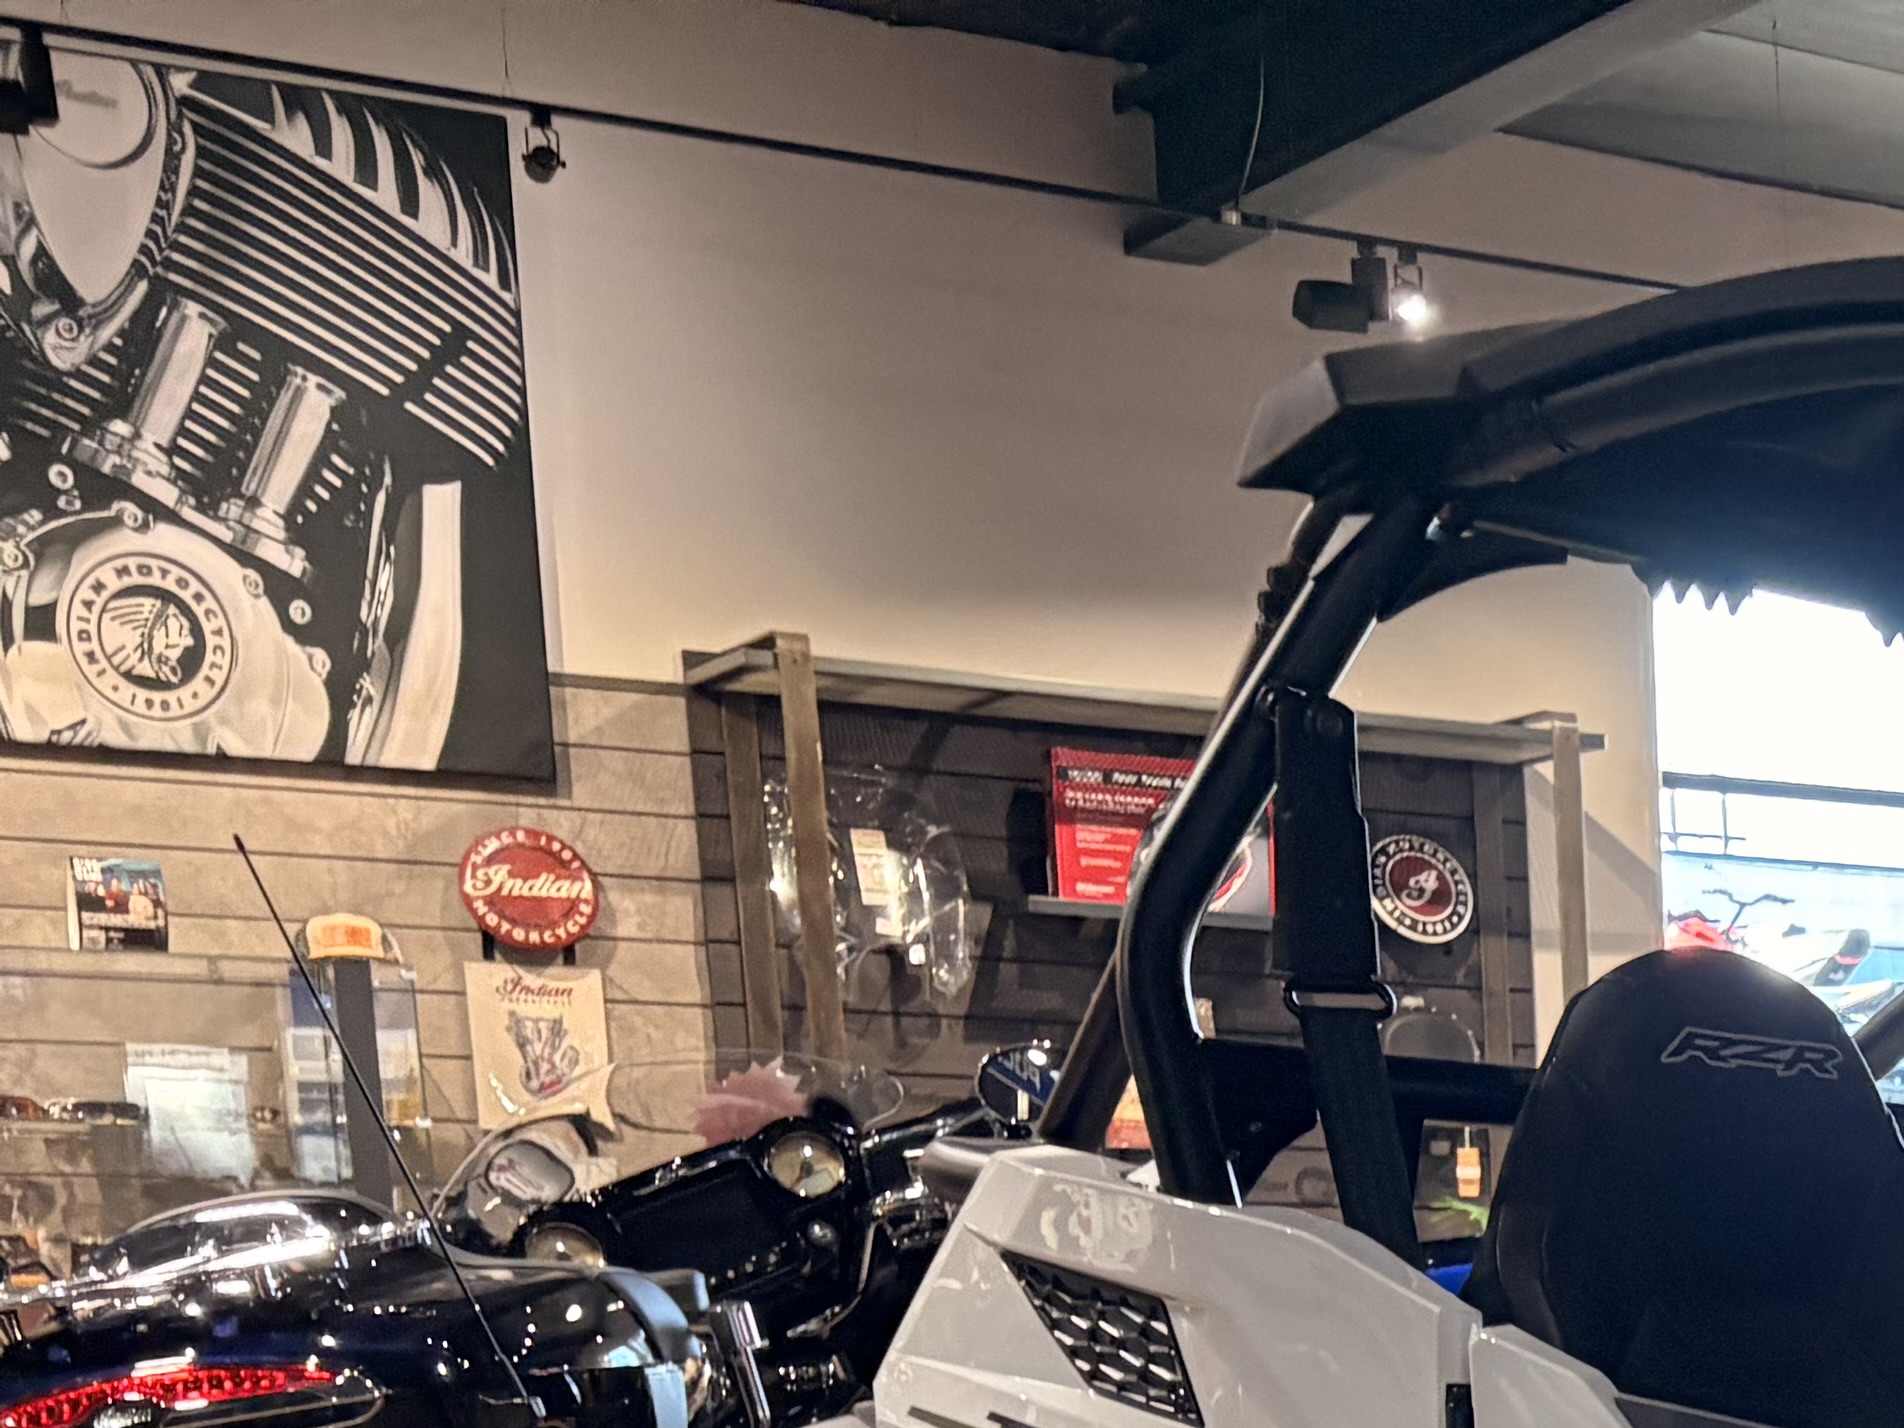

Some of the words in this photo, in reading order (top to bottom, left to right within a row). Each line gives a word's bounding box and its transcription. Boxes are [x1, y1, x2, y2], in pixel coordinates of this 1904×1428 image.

[76, 577, 108, 678] INDIAN
[113, 563, 226, 690] MOTORCYCLE
[469, 828, 527, 865] SINCE
[463, 863, 593, 899] Indian
[472, 898, 593, 945] MOTORCYCLE
[496, 975, 574, 999] Indian
[1660, 1025, 1844, 1081] RZR
